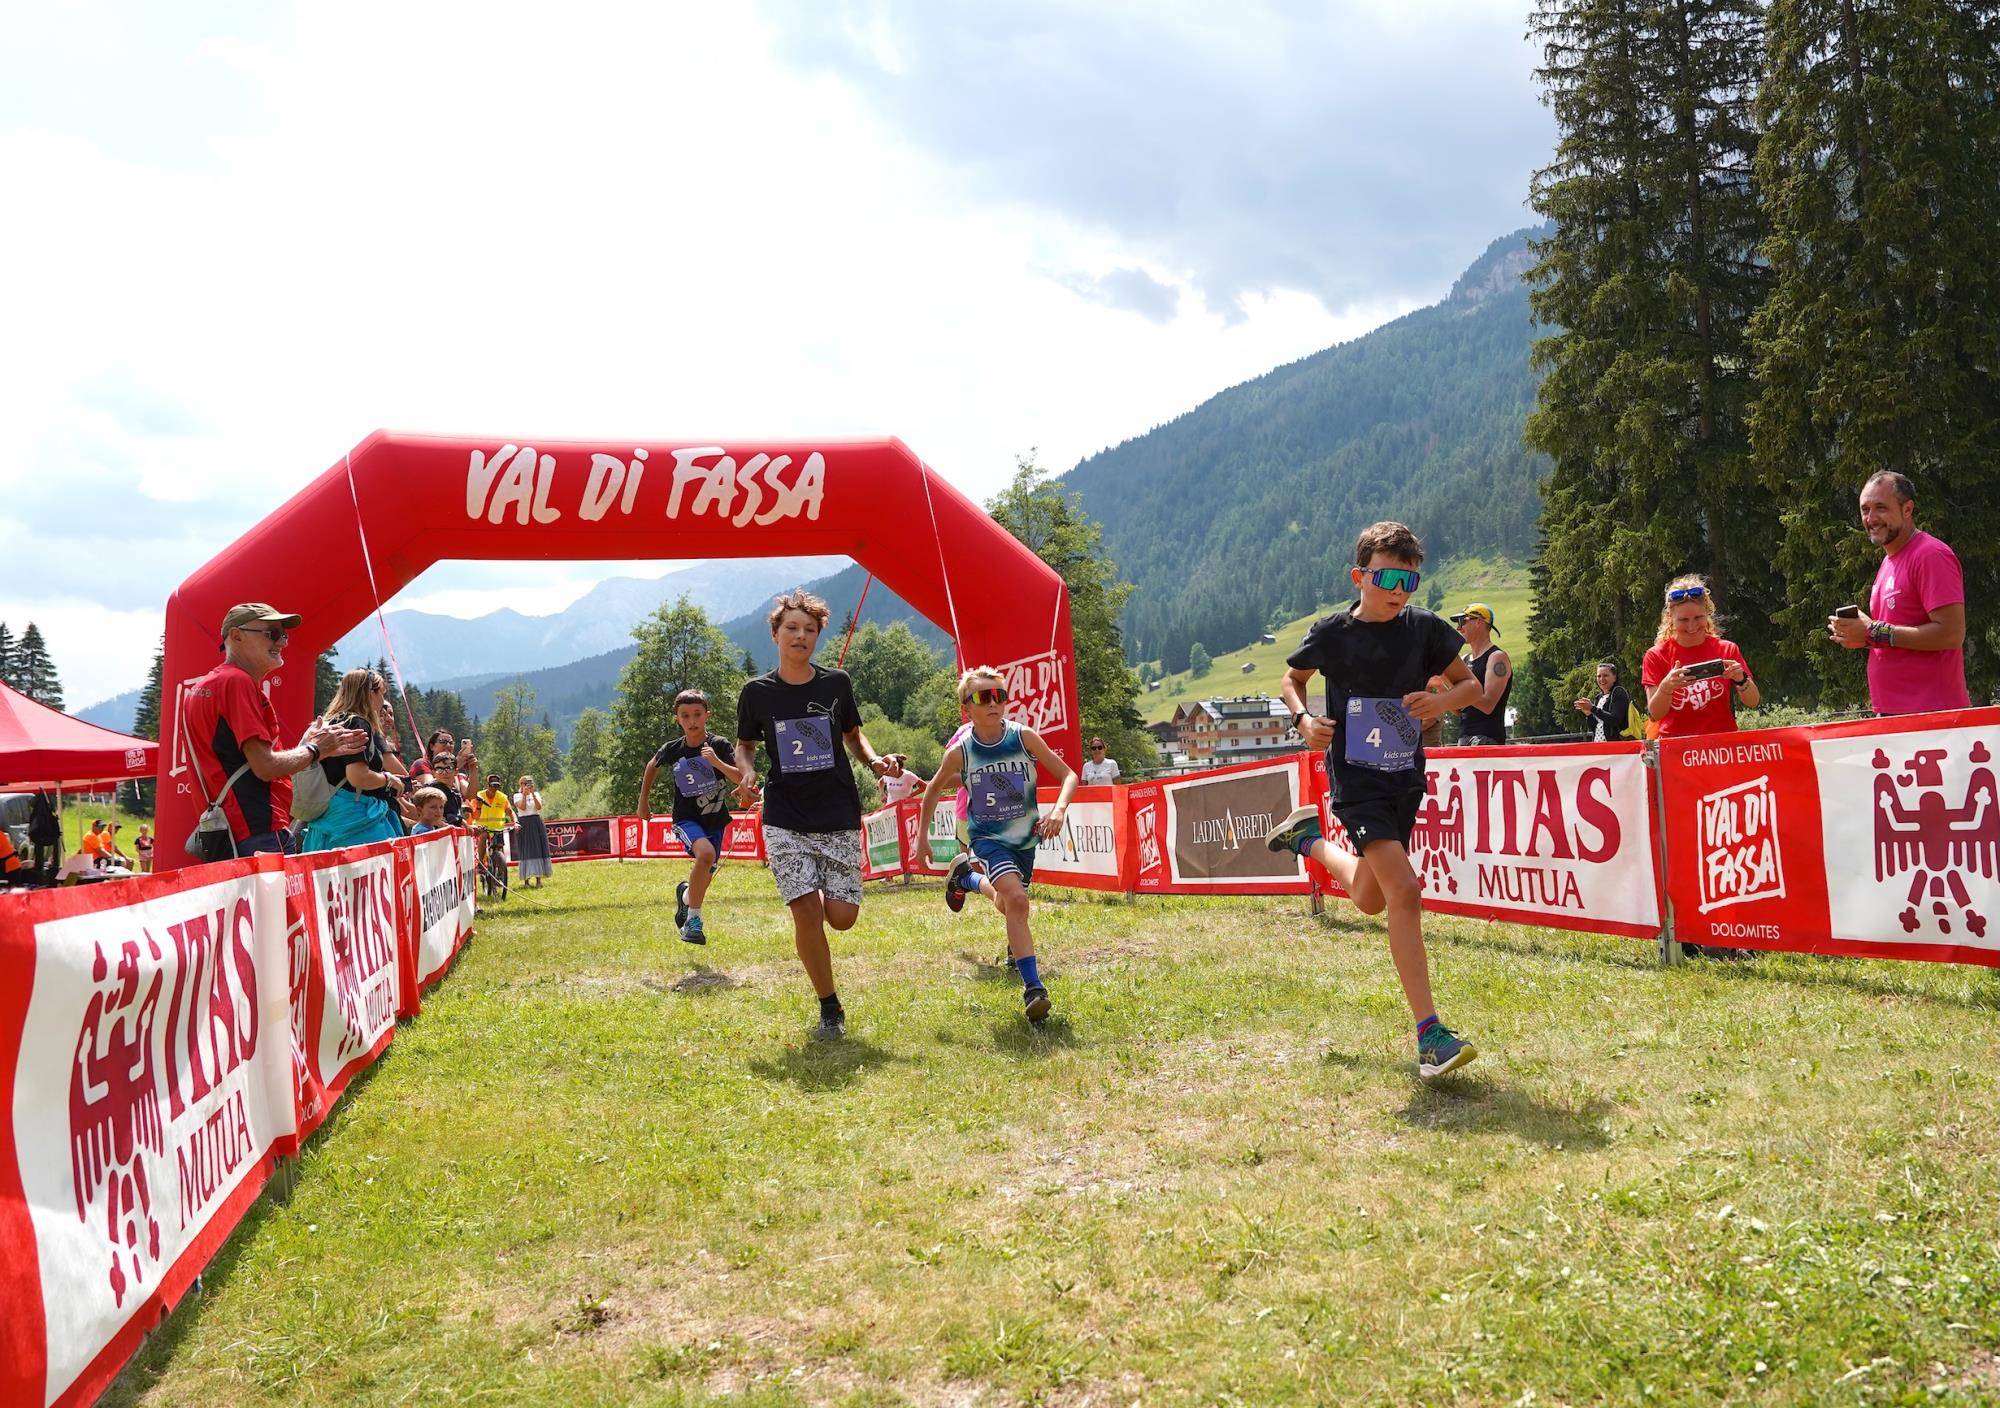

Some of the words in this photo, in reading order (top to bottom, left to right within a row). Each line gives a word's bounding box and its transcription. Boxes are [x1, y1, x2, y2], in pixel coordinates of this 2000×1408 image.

[466, 444, 561, 526] VAL
[665, 446, 826, 528] FASSA
[792, 740, 804, 755] 2
[1366, 728, 1382, 748] 4
[1383, 751, 1399, 759] kids
[1682, 747, 1734, 768] GRANDI
[1736, 743, 1783, 764] EVENTI
[685, 773, 695, 785] 3
[986, 792, 997, 807] 5
[1473, 767, 1622, 864] ITAS
[545, 824, 583, 835] OLOMIA
[936, 810, 956, 837] FASS
[1704, 797, 1743, 848] VAL
[1477, 863, 1585, 910] MUTUA
[1705, 838, 1777, 899] FASSA
[352, 866, 394, 983] ITAS
[1711, 922, 1781, 940] DOLOMITES
[166, 897, 258, 1123] ITAS
[364, 976, 395, 1040] MUTUA
[176, 1089, 253, 1231] MUTUA
